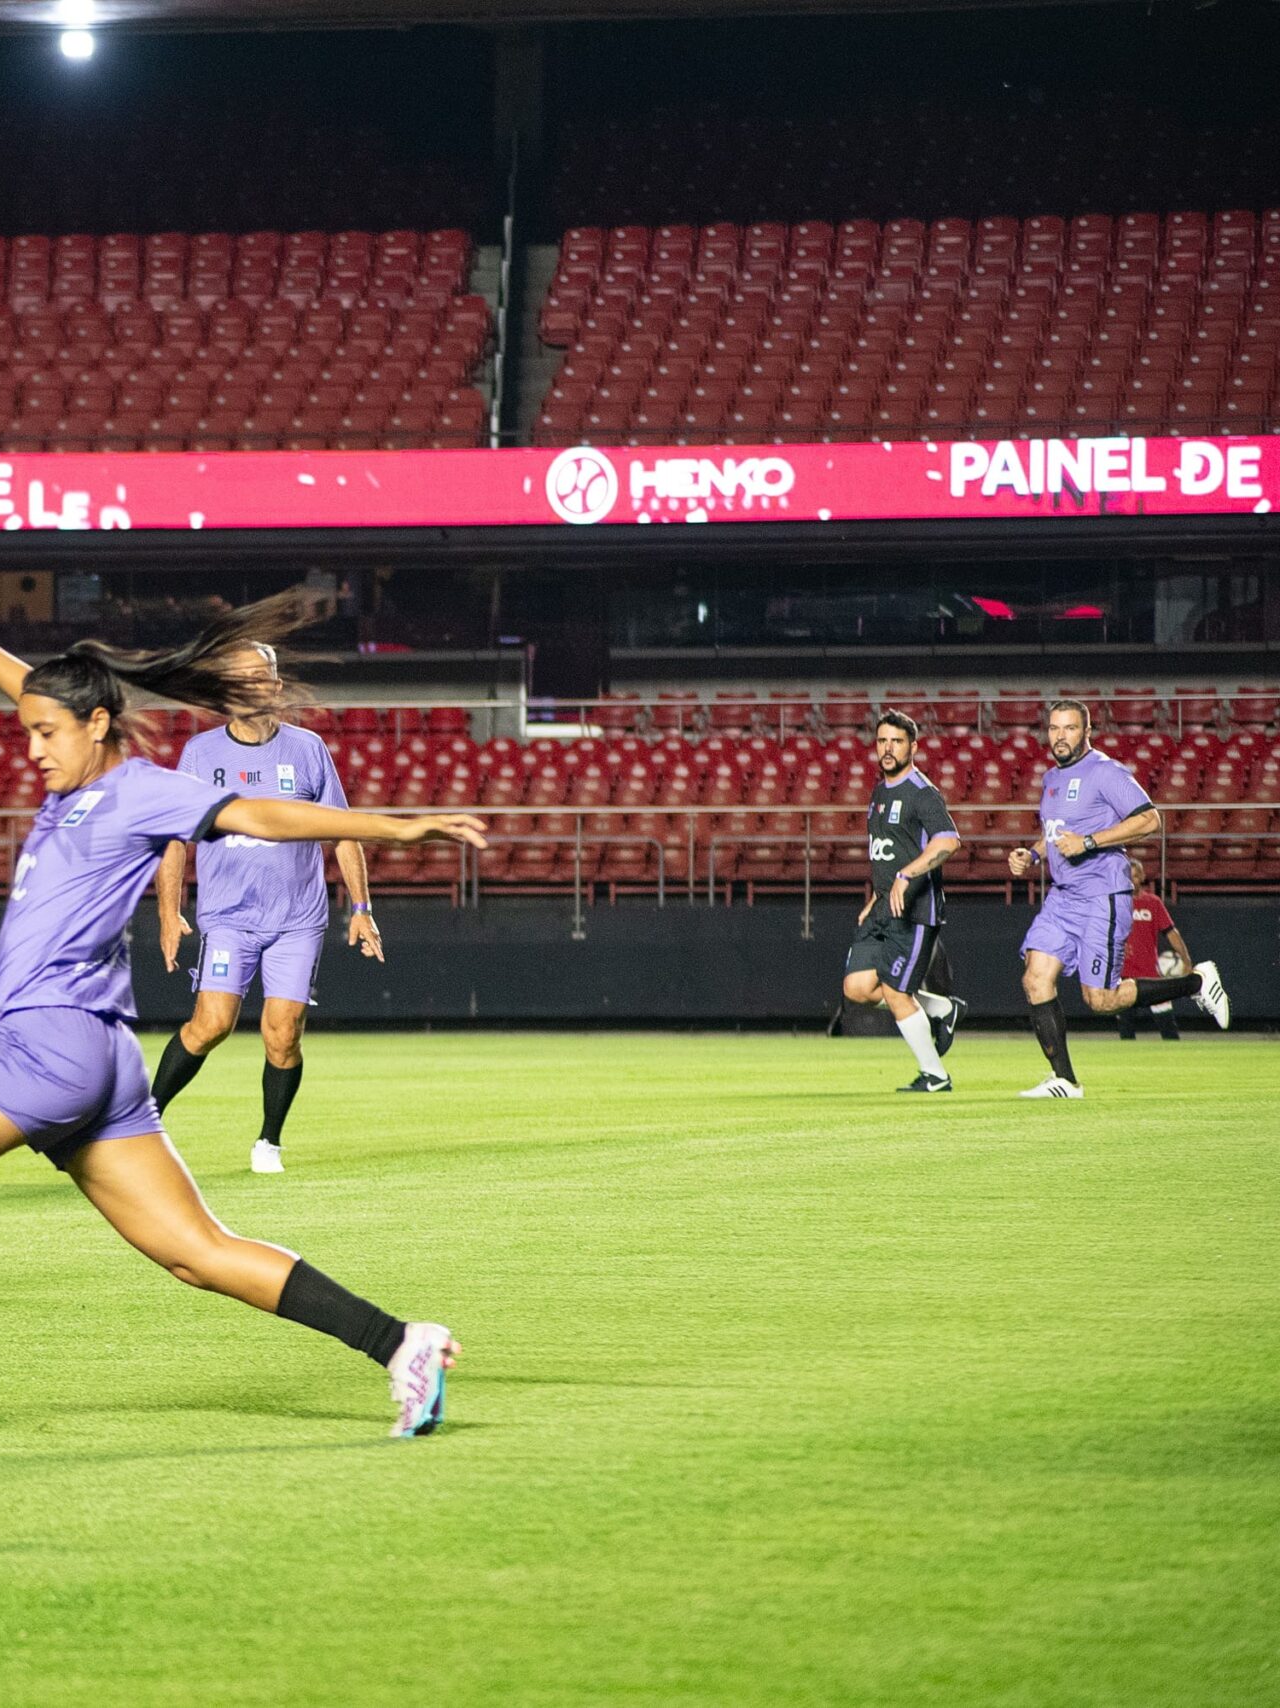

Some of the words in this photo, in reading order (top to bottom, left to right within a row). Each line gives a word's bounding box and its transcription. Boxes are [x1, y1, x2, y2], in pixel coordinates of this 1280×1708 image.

[950, 437, 1167, 497] PAINEL
[1179, 441, 1263, 498] DE
[213, 768, 225, 788] 8
[1091, 959, 1102, 975] 8
